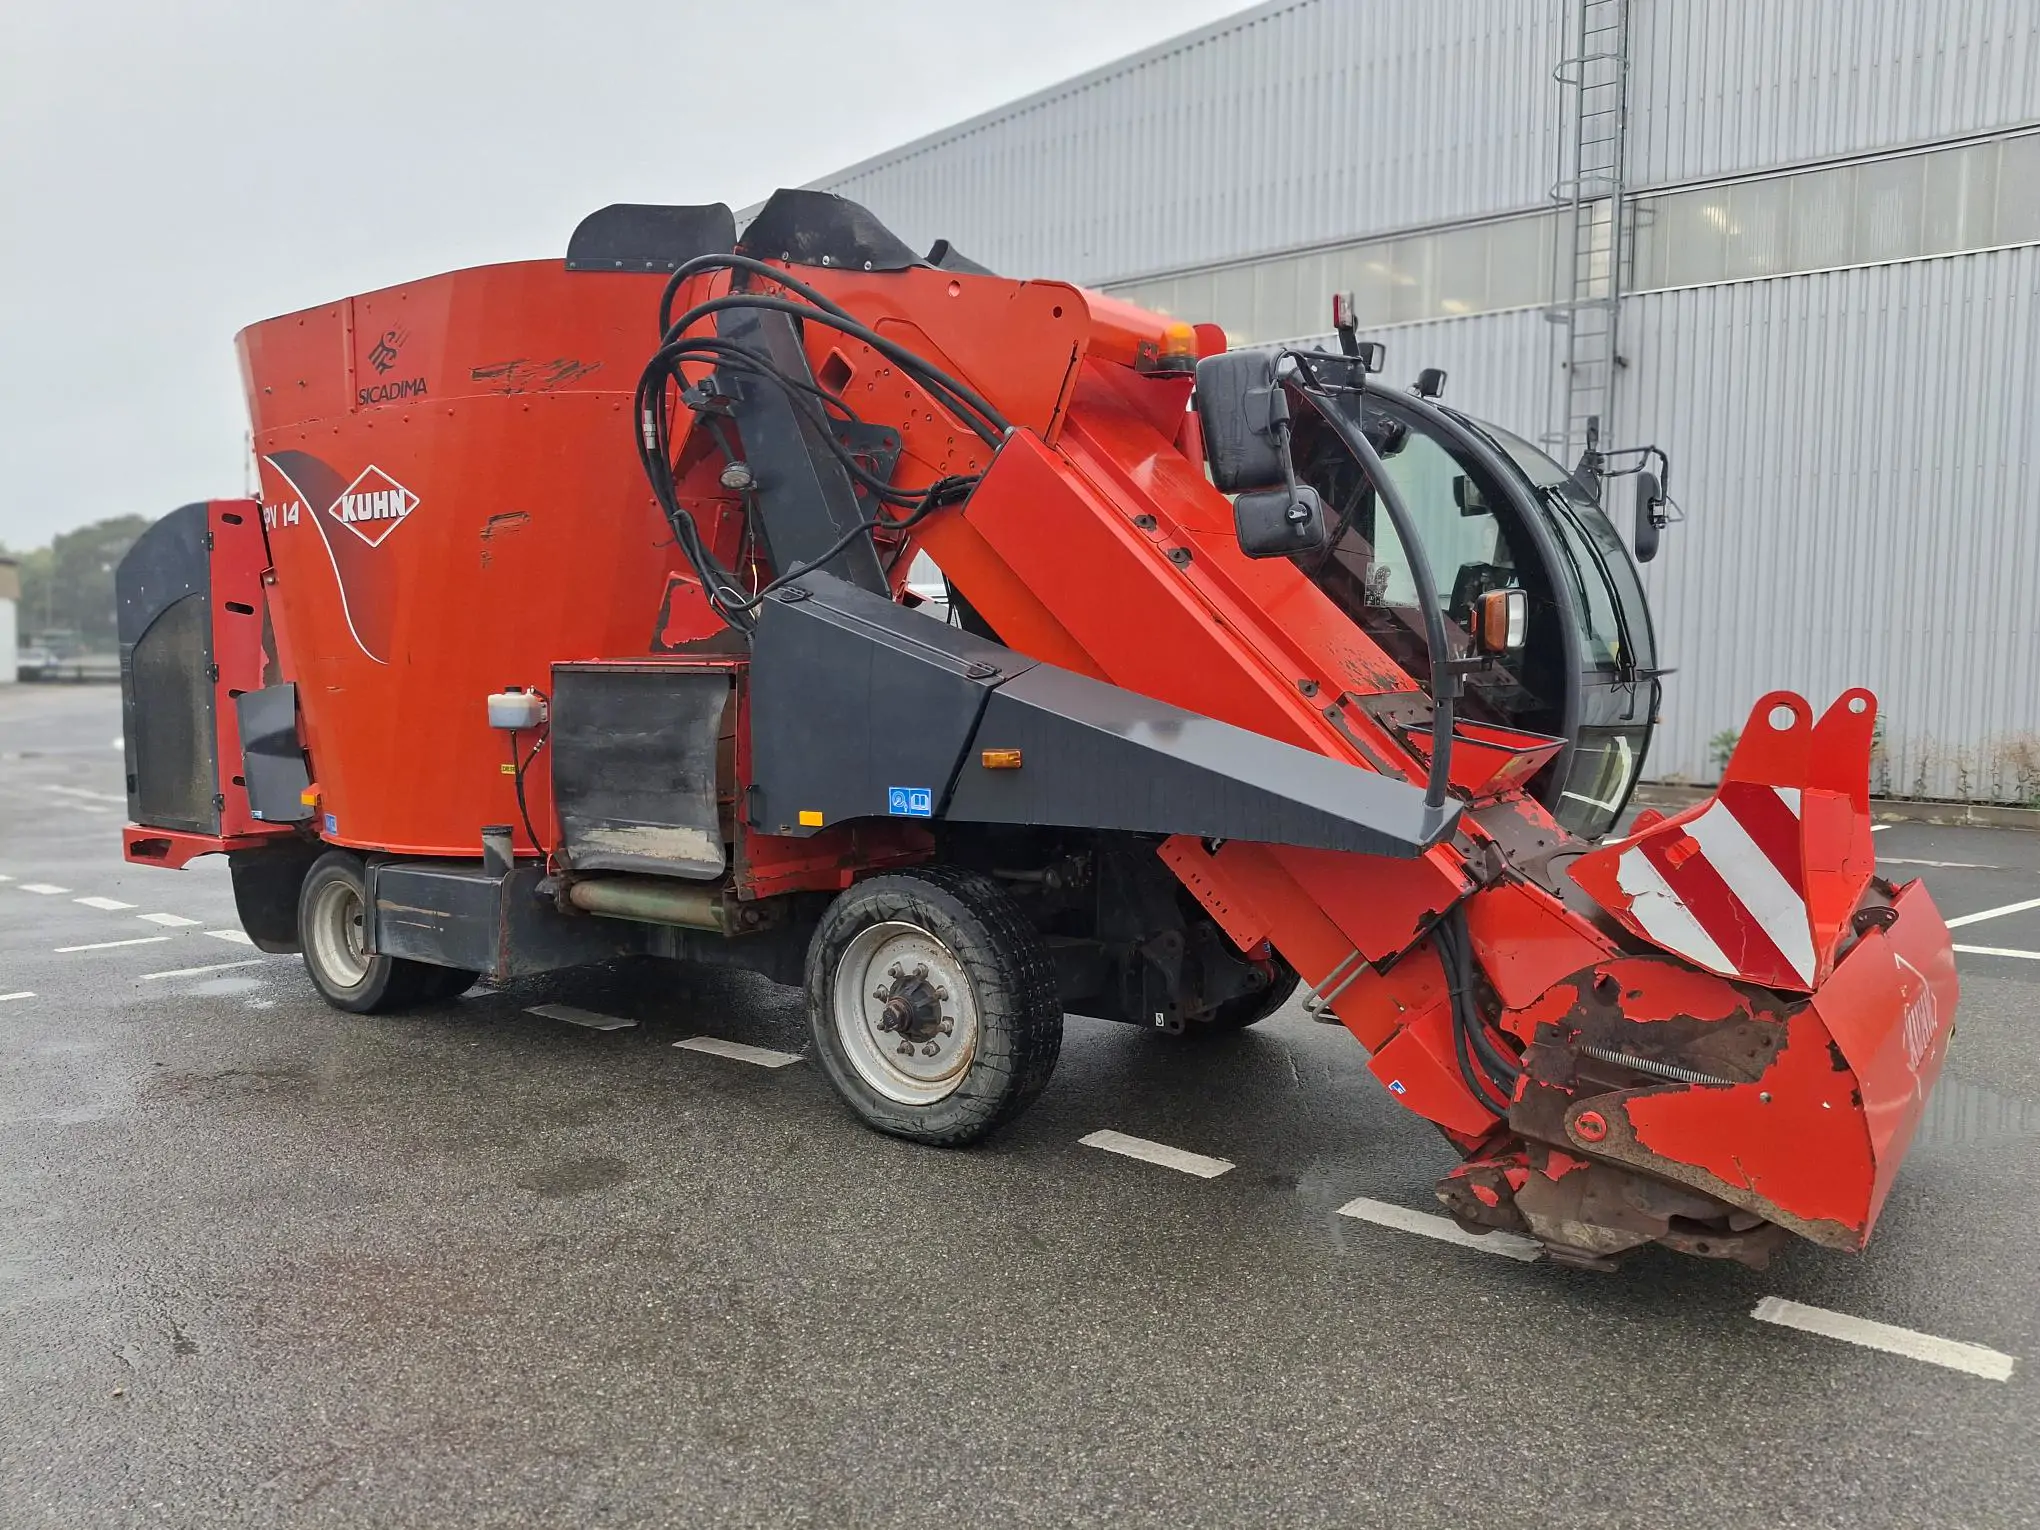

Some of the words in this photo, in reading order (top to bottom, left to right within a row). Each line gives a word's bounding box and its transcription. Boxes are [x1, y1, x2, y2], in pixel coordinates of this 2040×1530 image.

[359, 378, 427, 405] SICADIMA
[282, 501, 299, 527] 14
[342, 489, 406, 523] KUHN
